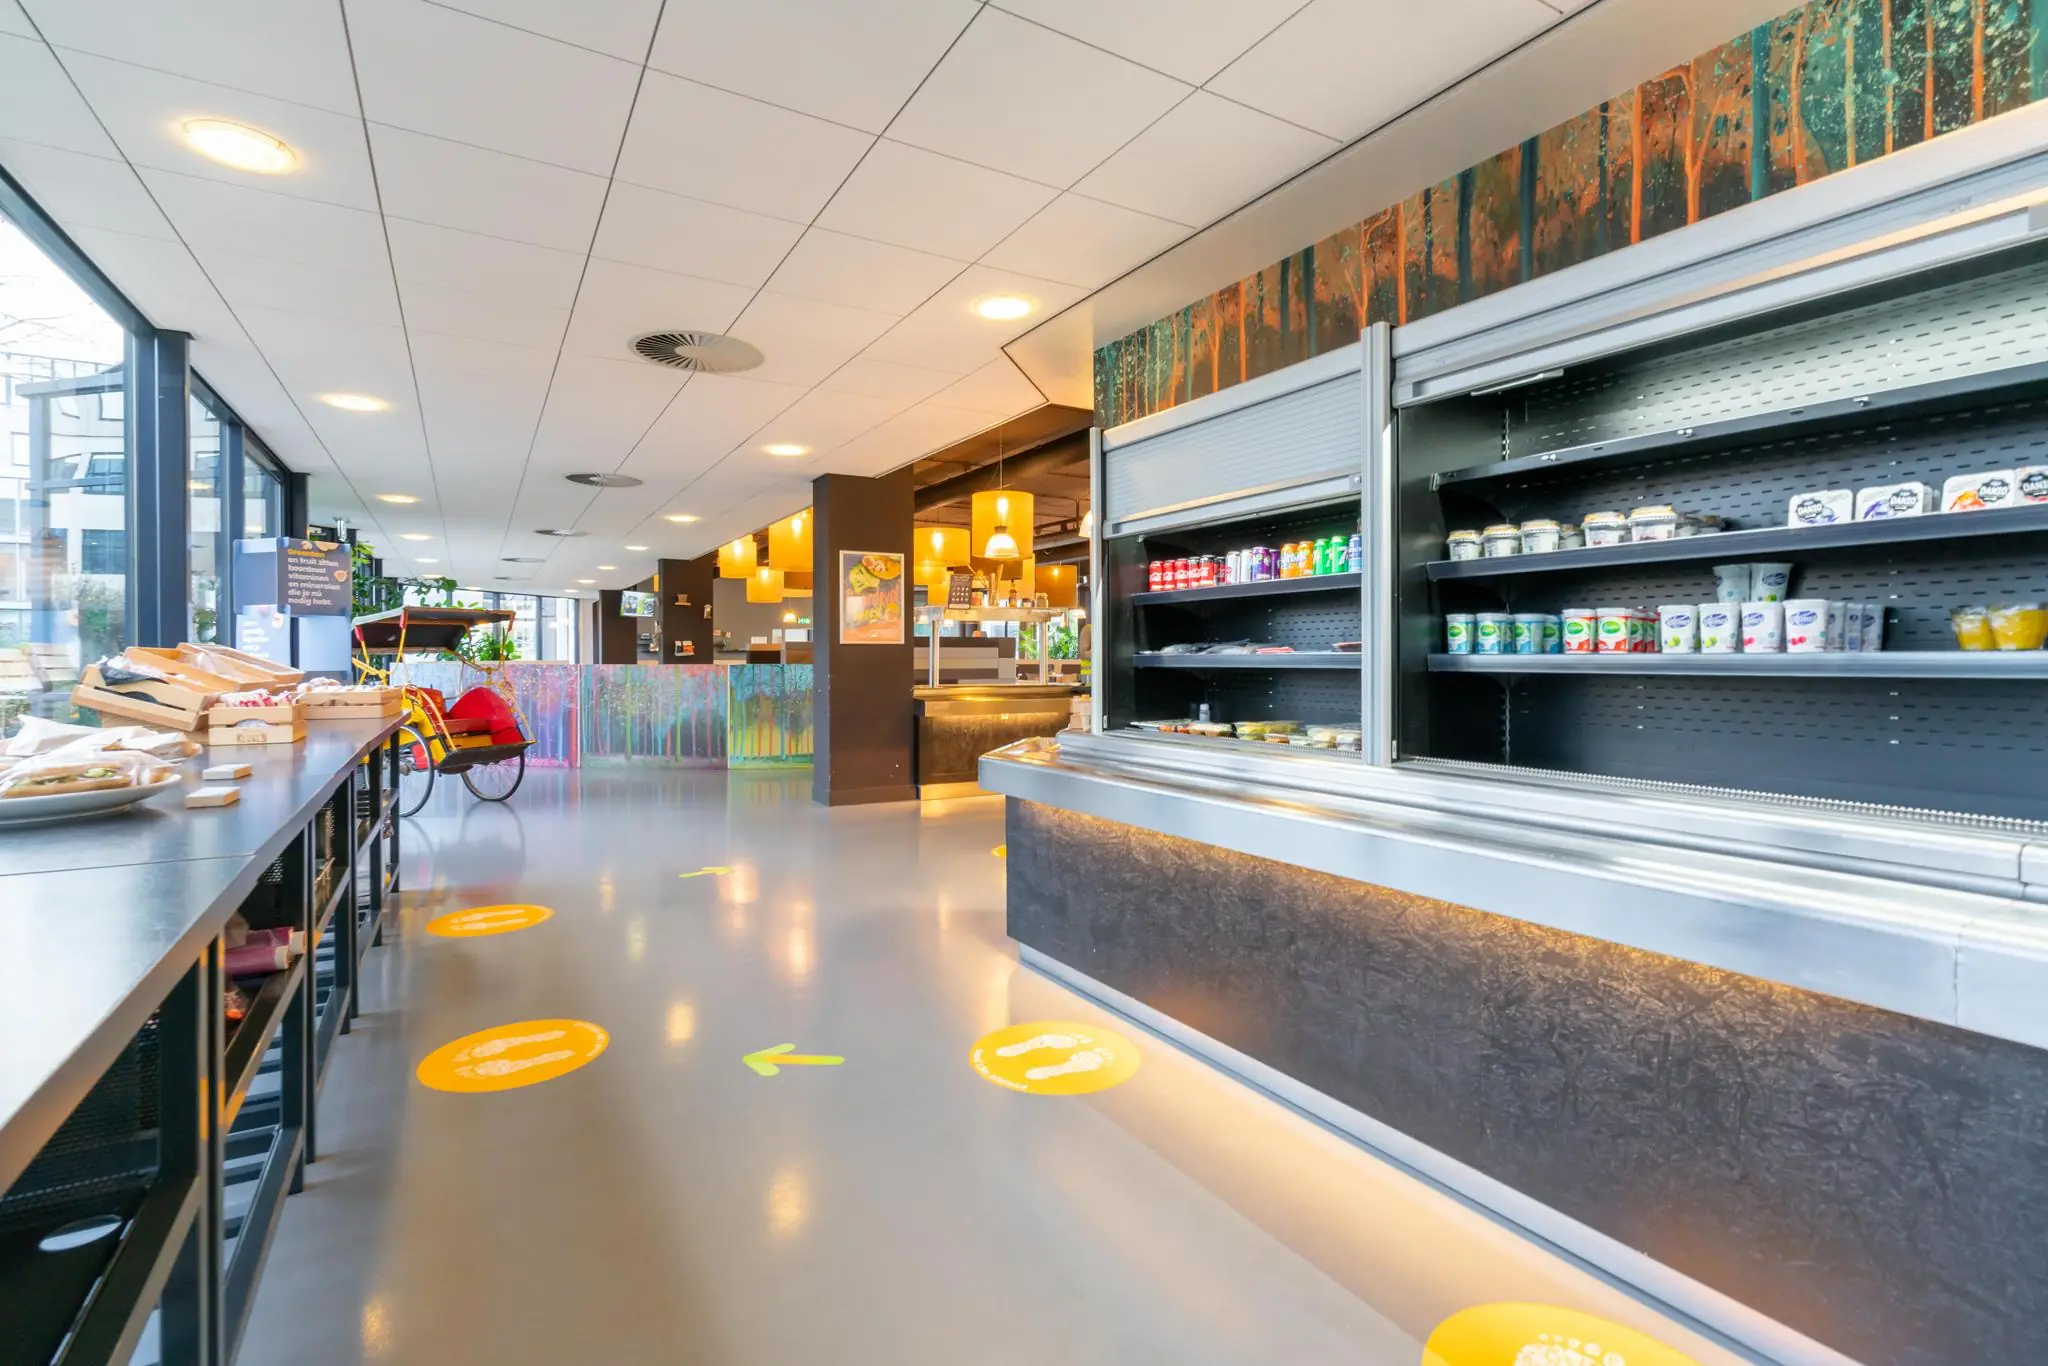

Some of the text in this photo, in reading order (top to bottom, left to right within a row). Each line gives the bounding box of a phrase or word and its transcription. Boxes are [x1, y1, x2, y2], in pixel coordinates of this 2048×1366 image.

[300, 557, 317, 565] fruit
[288, 565, 326, 573] boordevol
[288, 573, 330, 582] vitaminen
[300, 582, 341, 590] mineralen
[302, 589, 310, 597] je
[288, 597, 312, 606] nodig
